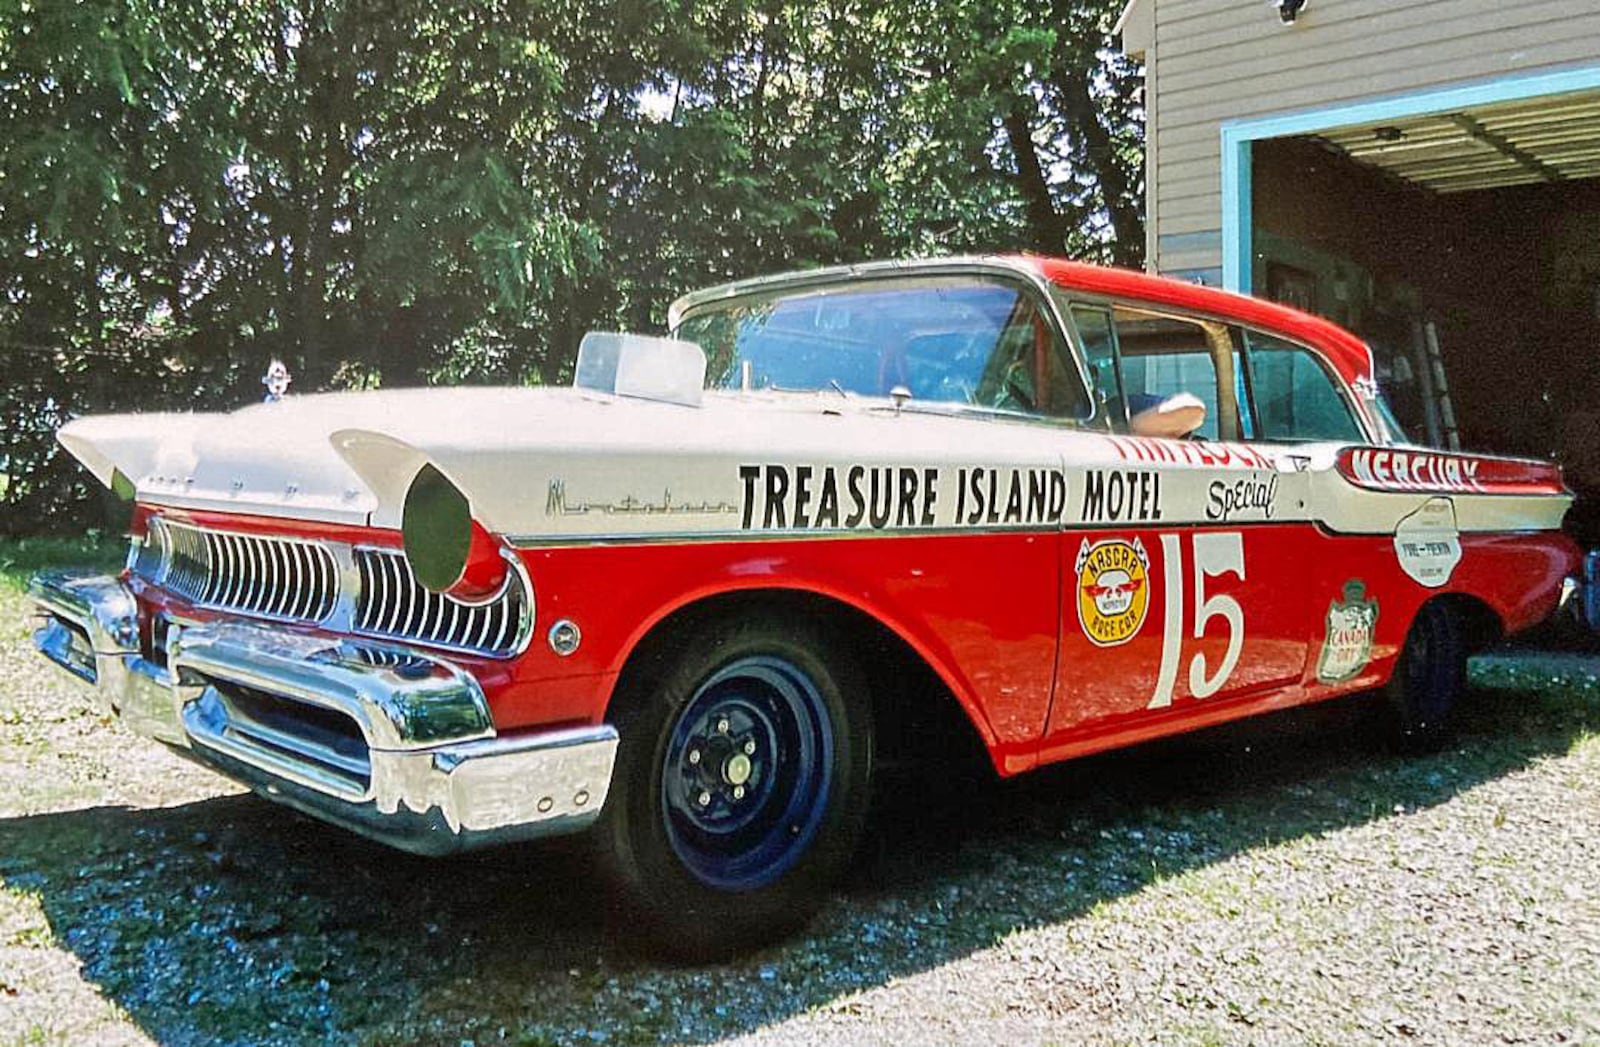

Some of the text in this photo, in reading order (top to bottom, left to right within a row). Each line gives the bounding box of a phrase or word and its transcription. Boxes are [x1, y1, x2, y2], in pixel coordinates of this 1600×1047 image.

[1351, 450, 1487, 492] MERCURY
[739, 466, 939, 529] TREASURE
[955, 469, 1066, 524] ISLAND
[1081, 470, 1162, 521] MOTEL
[1087, 547, 1138, 579] NASCAR
[1092, 610, 1137, 637] RACE CAR
[1146, 532, 1246, 710] 15
[1331, 628, 1368, 646] CANADA
